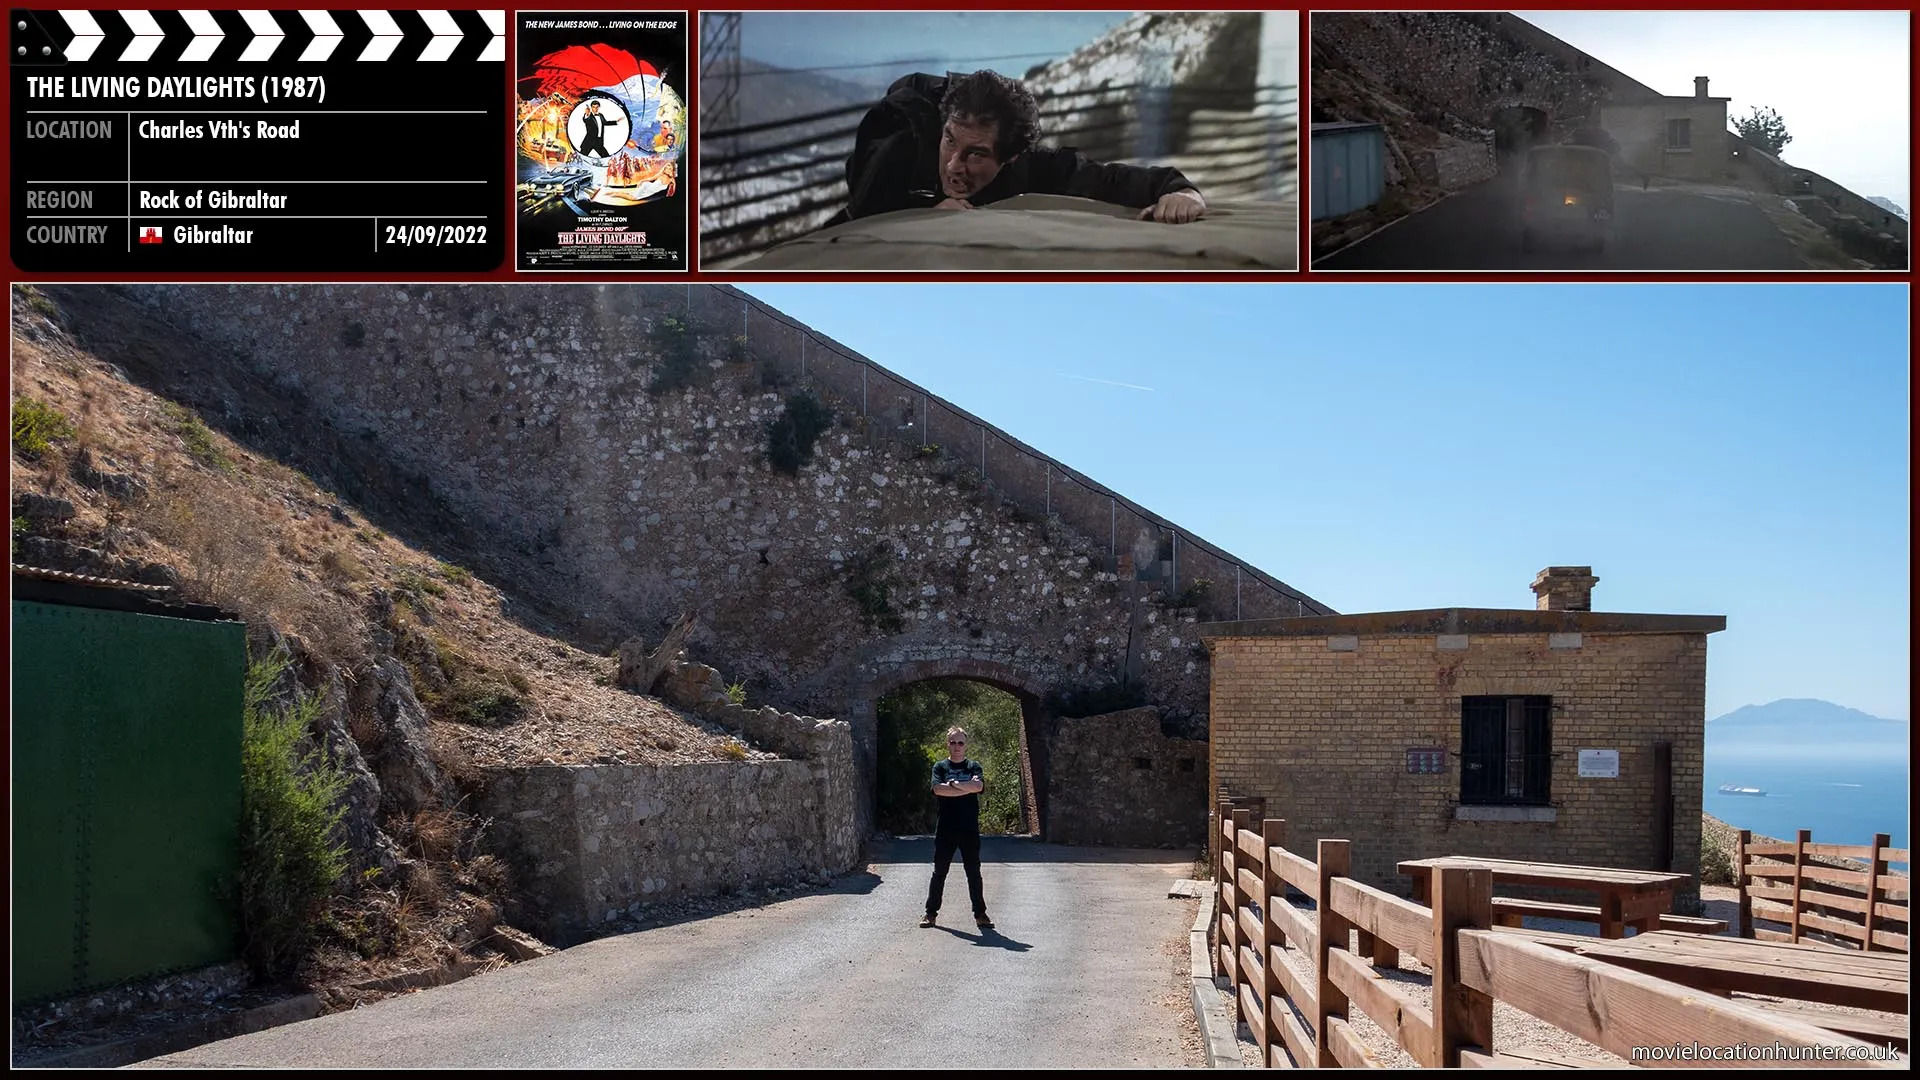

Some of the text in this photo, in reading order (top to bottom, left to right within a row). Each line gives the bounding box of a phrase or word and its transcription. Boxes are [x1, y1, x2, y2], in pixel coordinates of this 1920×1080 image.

[525, 20, 538, 29] THE
[538, 20, 555, 29] NEW
[555, 20, 578, 29] JAMES
[609, 20, 632, 29] LIVING
[633, 20, 645, 29] ON
[645, 20, 658, 29] THE
[658, 20, 678, 29] EDGE
[558, 232, 646, 245] THE LIVING DAYLIGHTS
